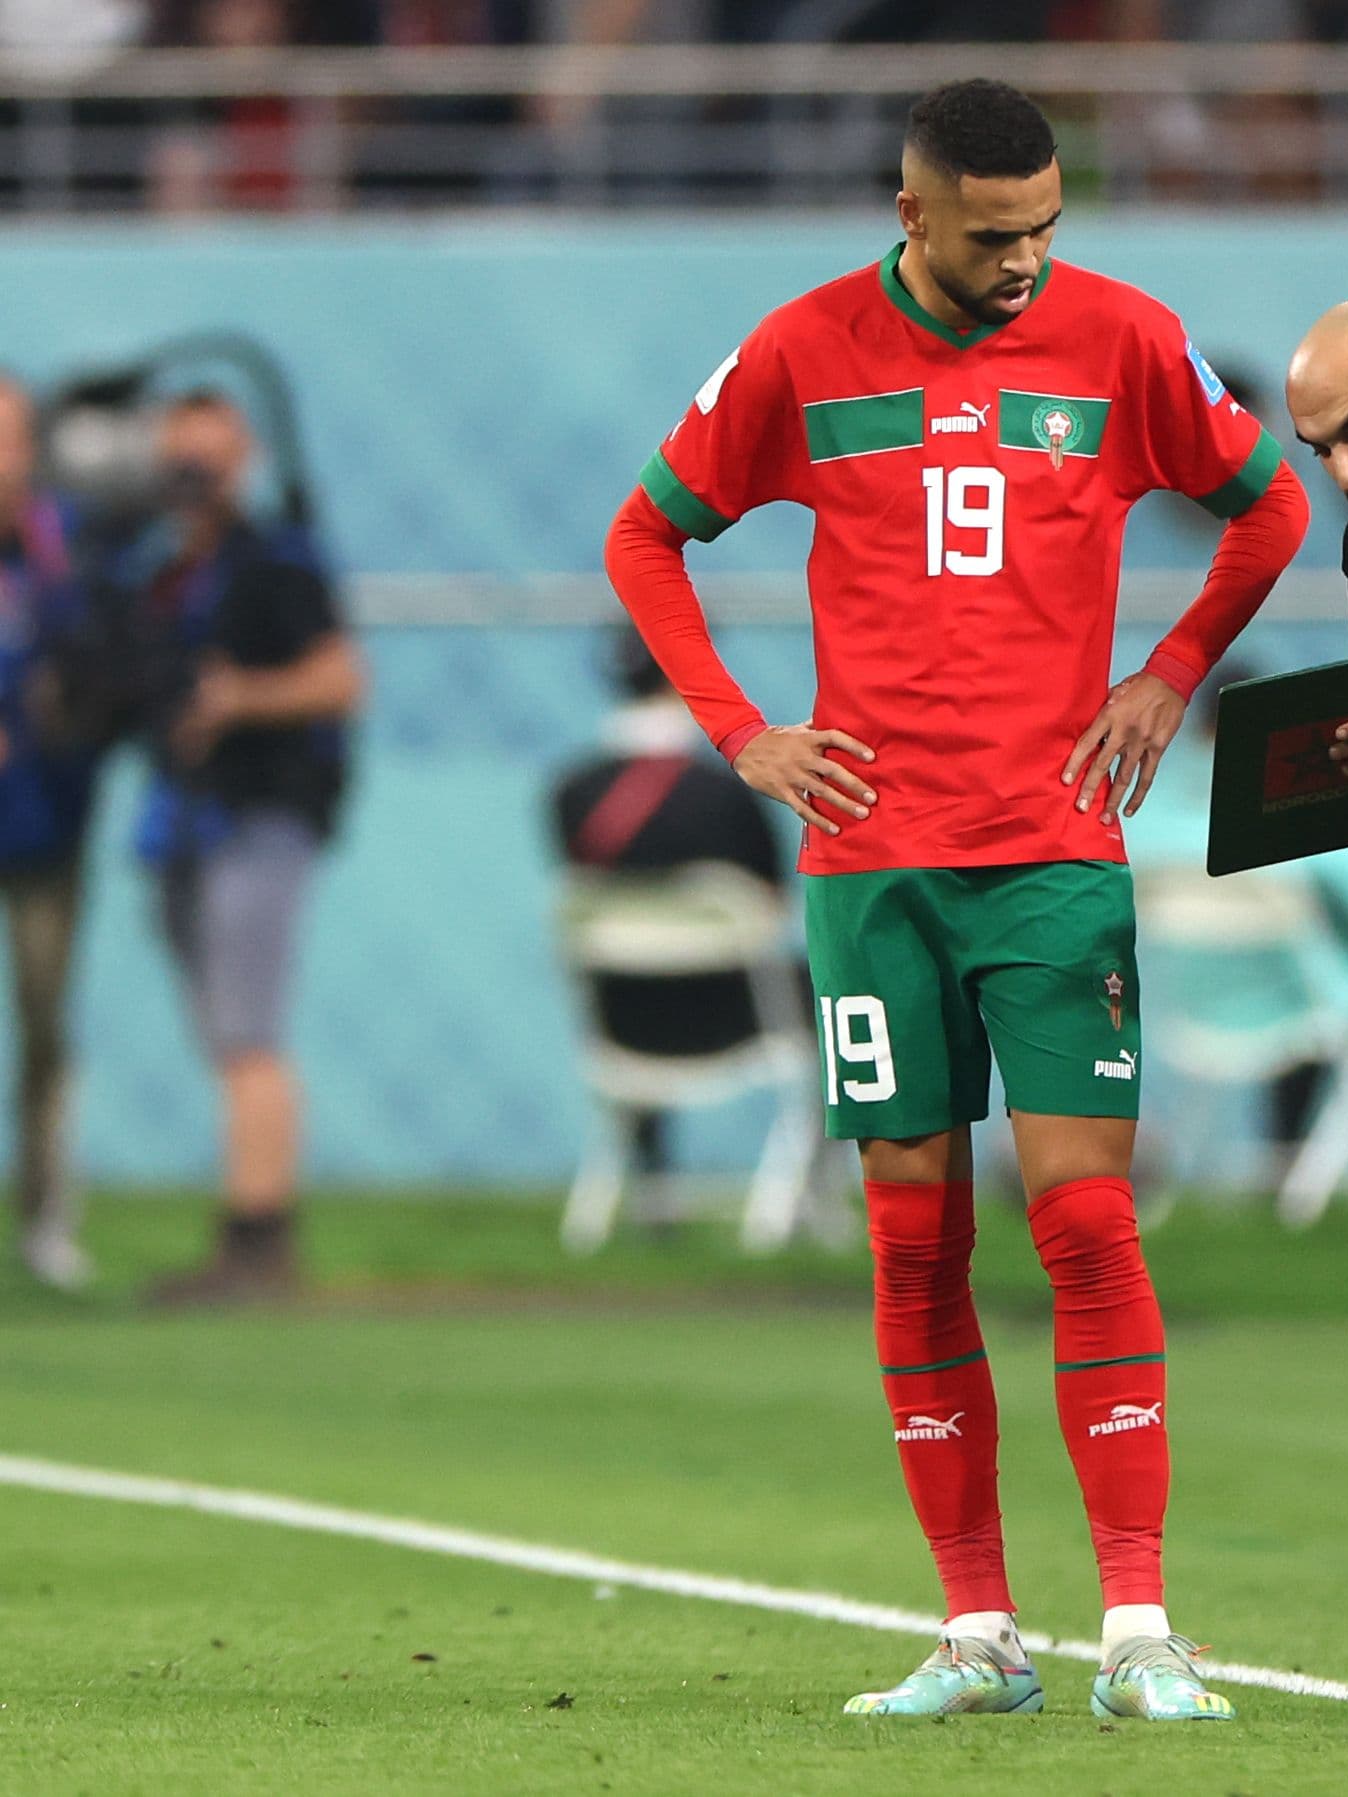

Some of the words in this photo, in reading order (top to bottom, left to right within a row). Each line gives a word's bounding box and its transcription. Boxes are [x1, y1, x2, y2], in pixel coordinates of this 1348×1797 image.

[931, 416, 978, 434] PUMA
[922, 466, 1006, 577] 19
[820, 995, 897, 1105] 19
[1094, 1060, 1132, 1080] PUMA
[894, 1427, 949, 1442] PUMA
[1088, 1414, 1150, 1437] PUMA
